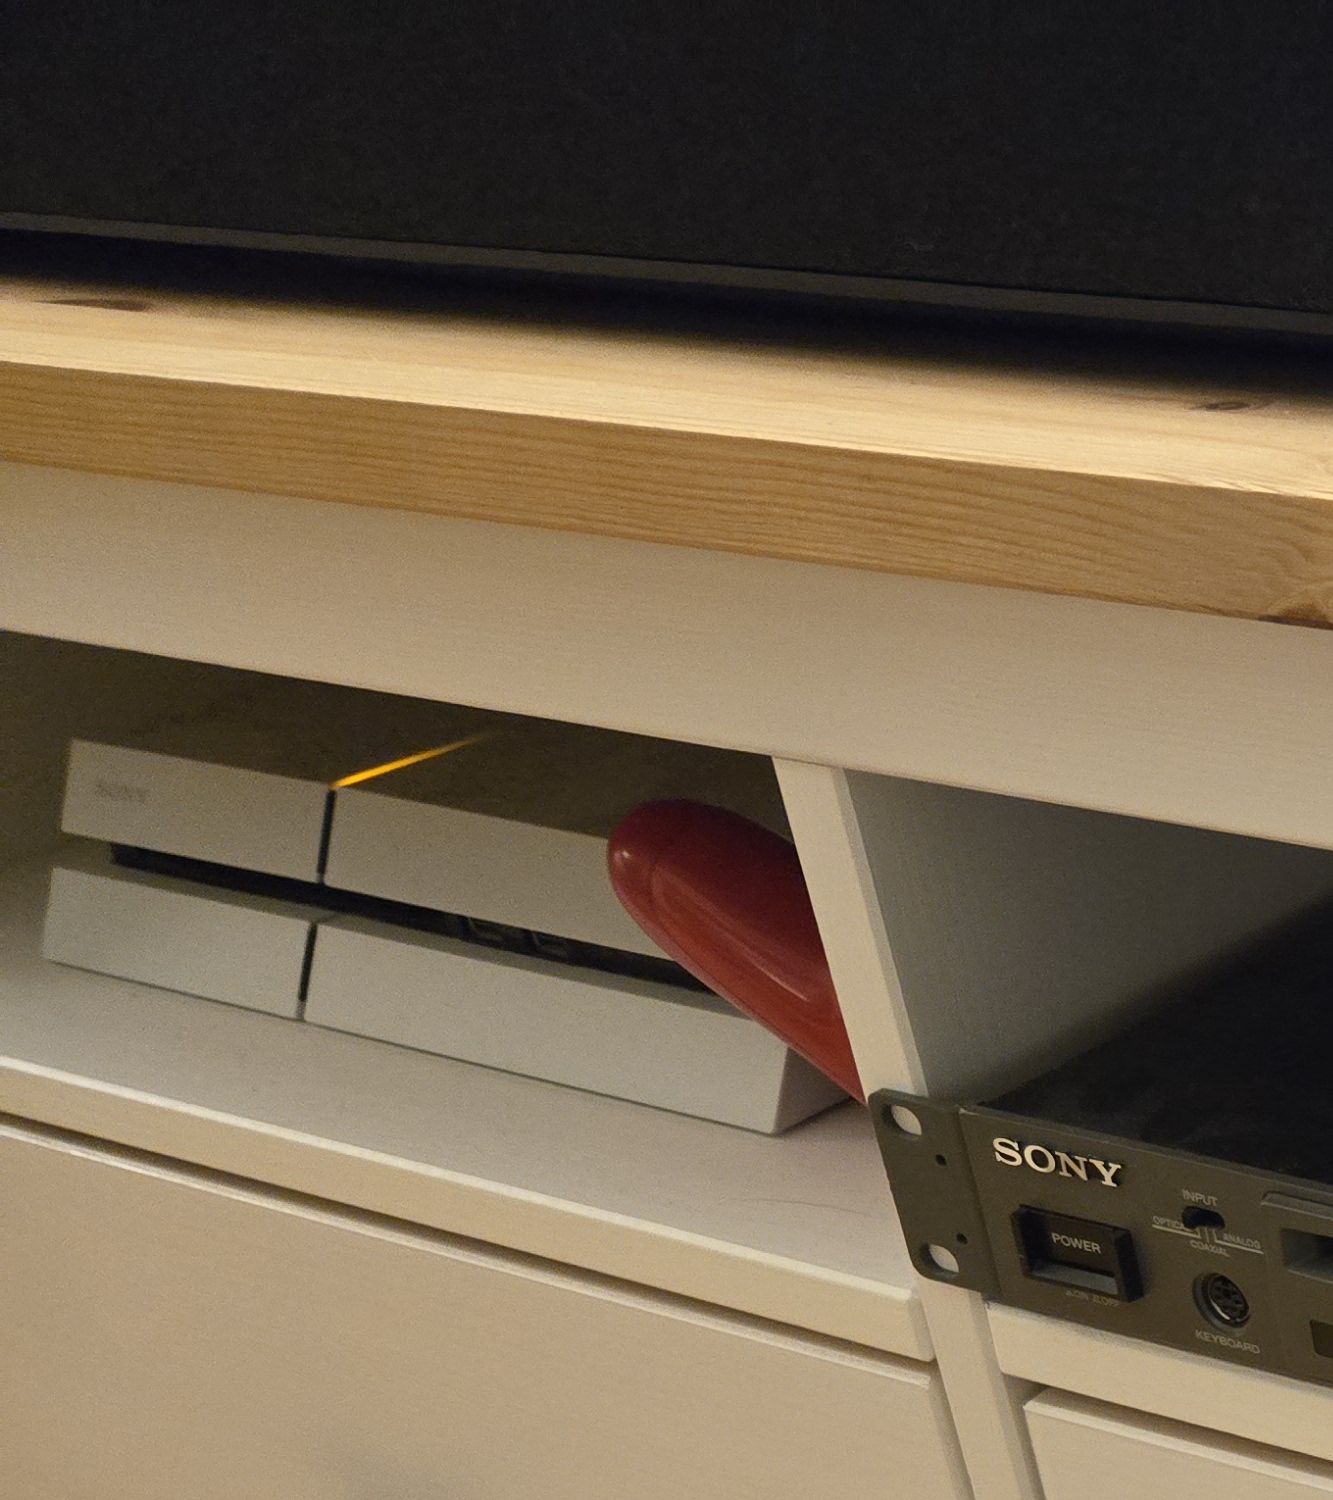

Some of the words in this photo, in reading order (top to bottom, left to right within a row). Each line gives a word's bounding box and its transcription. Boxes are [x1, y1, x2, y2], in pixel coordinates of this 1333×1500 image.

[992, 1137, 1122, 1187] SONY
[1181, 1188, 1219, 1207] INPUT
[1051, 1231, 1102, 1254] POWER
[1189, 1239, 1231, 1258] COAXIAL
[1223, 1232, 1262, 1250] ANALOG
[1195, 1329, 1261, 1355] KEYBOARD
